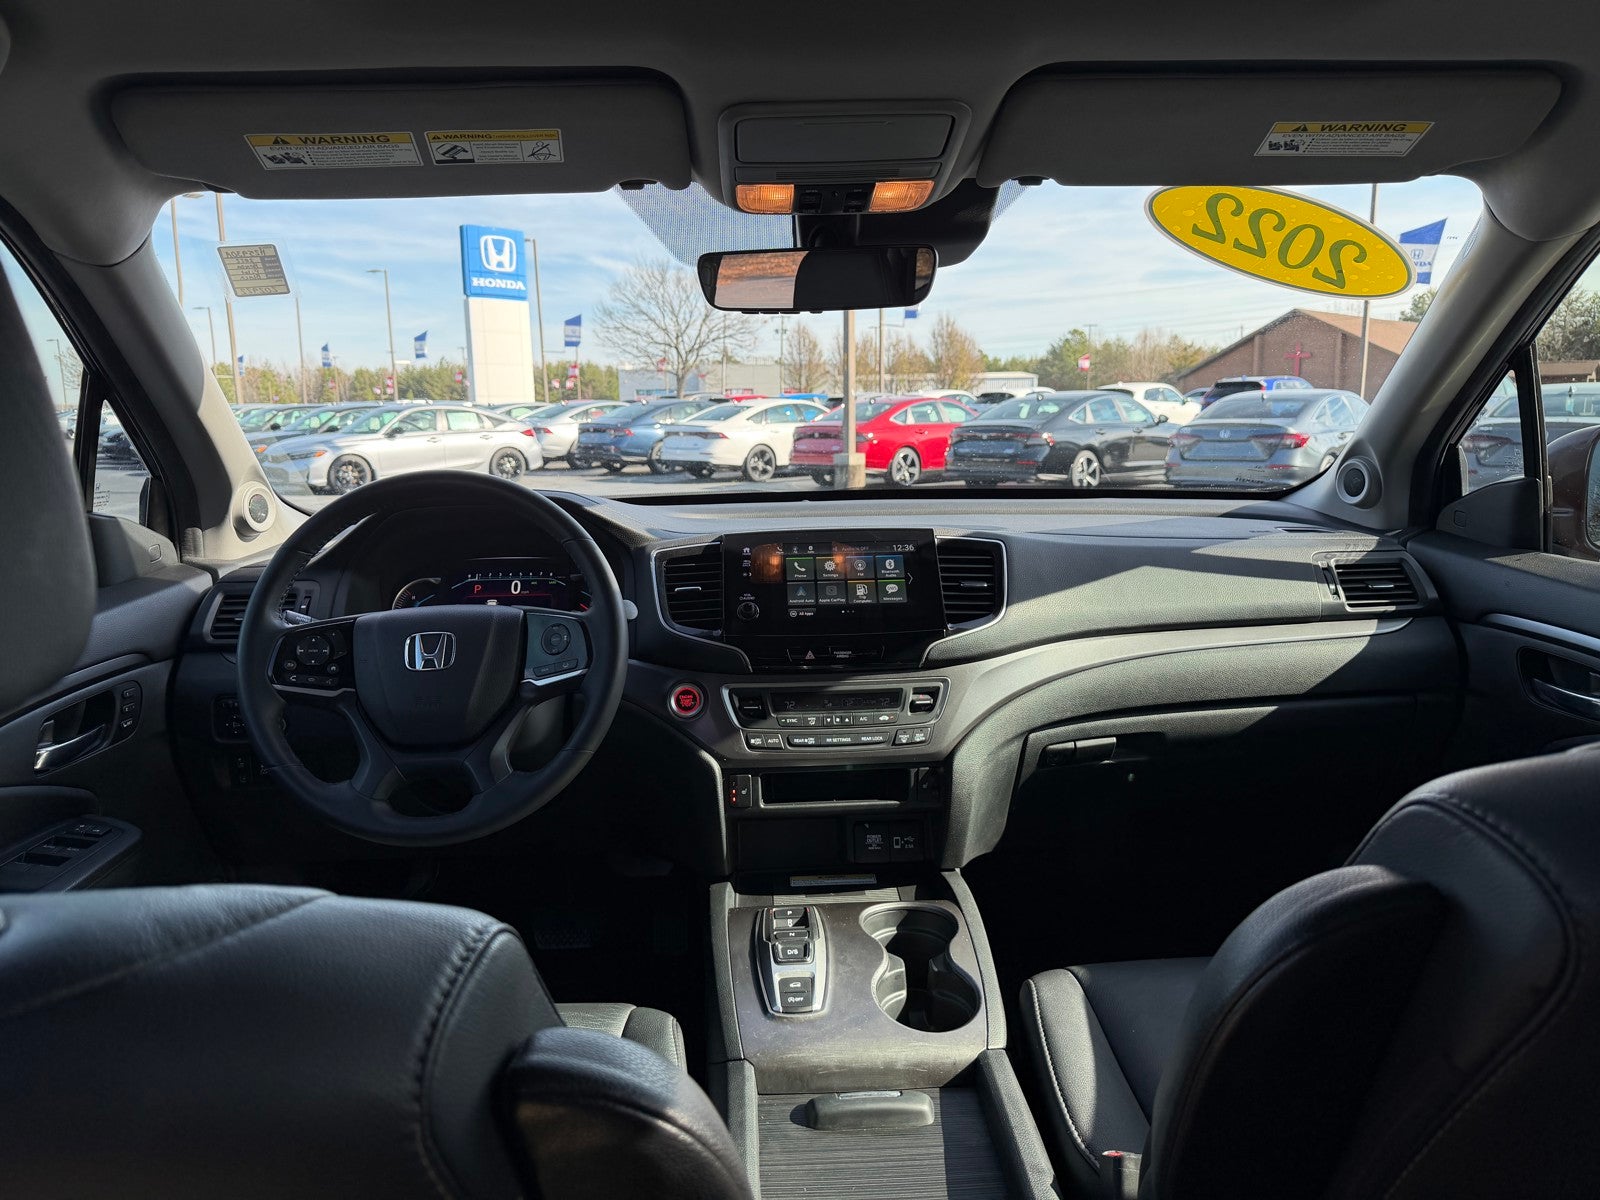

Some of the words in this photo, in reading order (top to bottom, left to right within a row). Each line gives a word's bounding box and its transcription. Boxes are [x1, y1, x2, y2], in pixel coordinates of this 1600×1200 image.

[1319, 123, 1408, 132] WARNING
[298, 134, 391, 145] WARNING
[472, 276, 527, 291] HONDA
[892, 544, 915, 552] 12:36
[474, 584, 482, 594] P
[510, 580, 521, 595] 0
